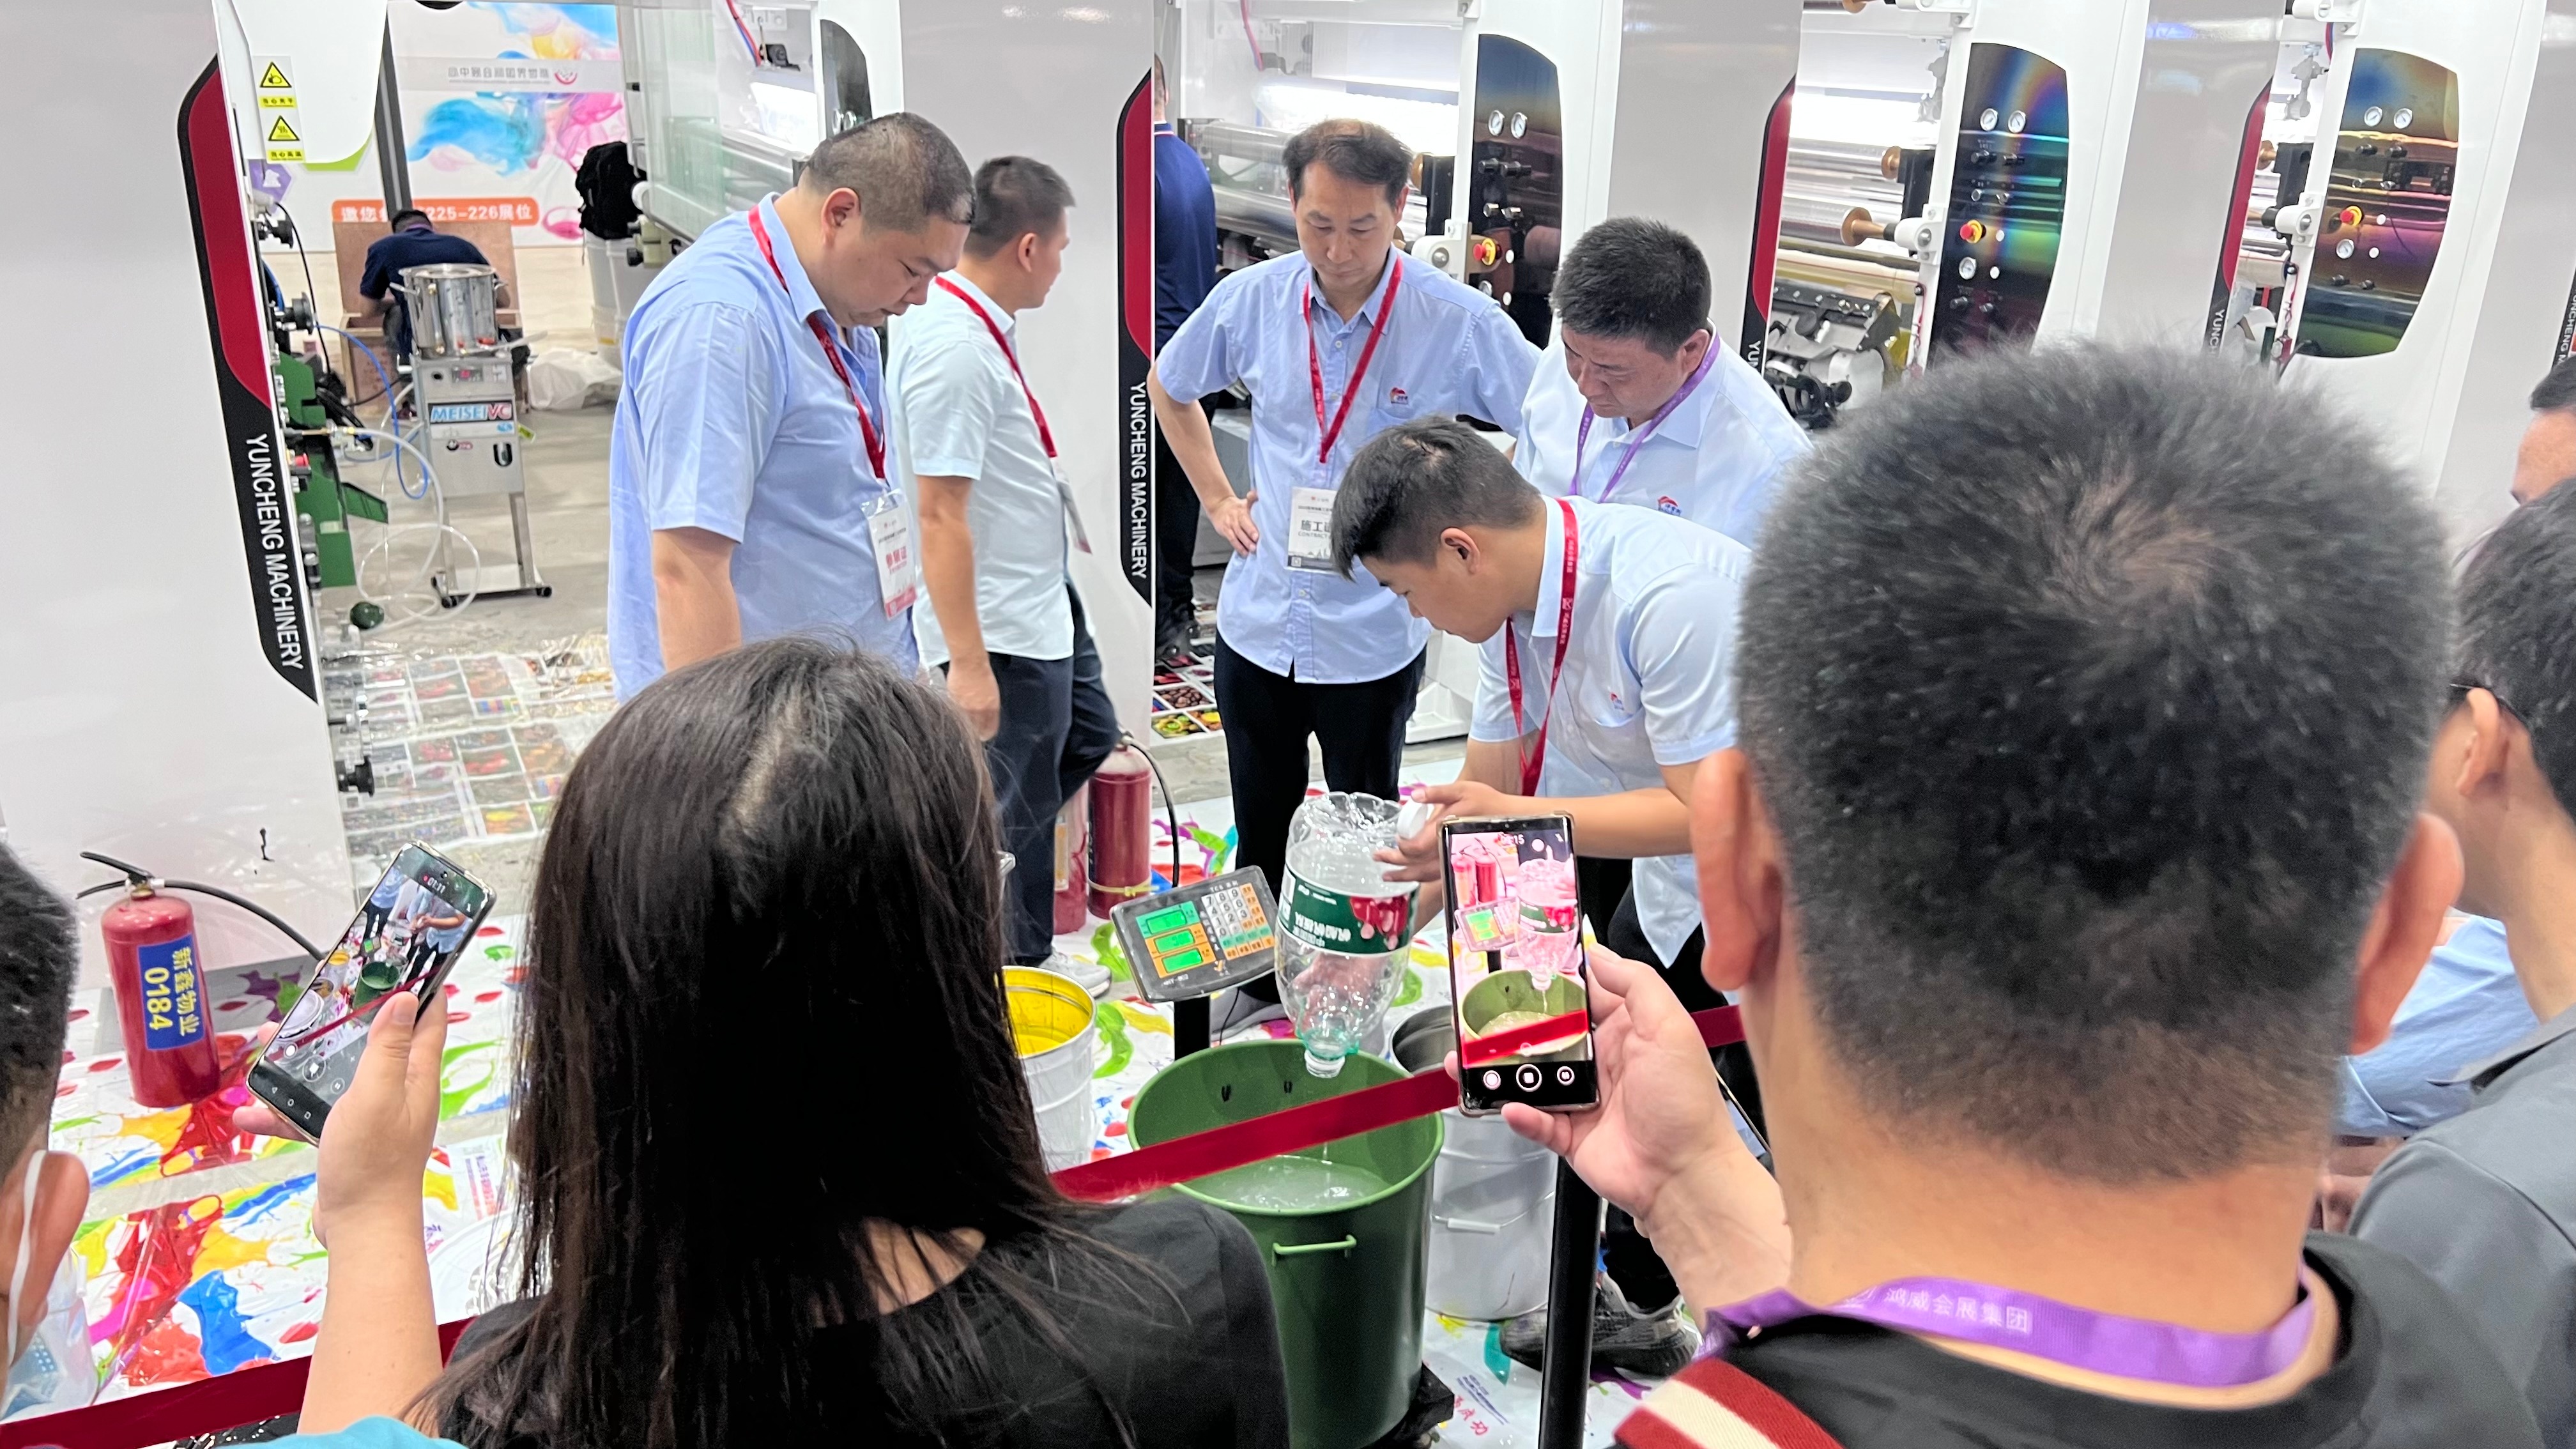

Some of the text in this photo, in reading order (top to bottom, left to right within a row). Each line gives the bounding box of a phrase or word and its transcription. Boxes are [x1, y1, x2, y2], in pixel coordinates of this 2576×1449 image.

[2561, 289, 2576, 351] UNCHENG
[1130, 381, 1147, 579] YUNCHENG MACHINERY
[246, 434, 304, 670] YUNCHENG MACHINERY
[1206, 896, 1212, 907] 7
[1219, 893, 1226, 901] 8
[1231, 889, 1238, 897] 9
[1216, 917, 1222, 926] 1
[1227, 914, 1234, 923] 2
[1240, 910, 1247, 918] 3
[1223, 903, 1230, 912] 5
[1236, 899, 1243, 908] 6
[1219, 928, 1226, 936] 0
[144, 967, 174, 1031] 0184
[172, 947, 201, 1036] 新鑫物业
[1885, 1287, 2028, 1333] 鸿威会展集团
